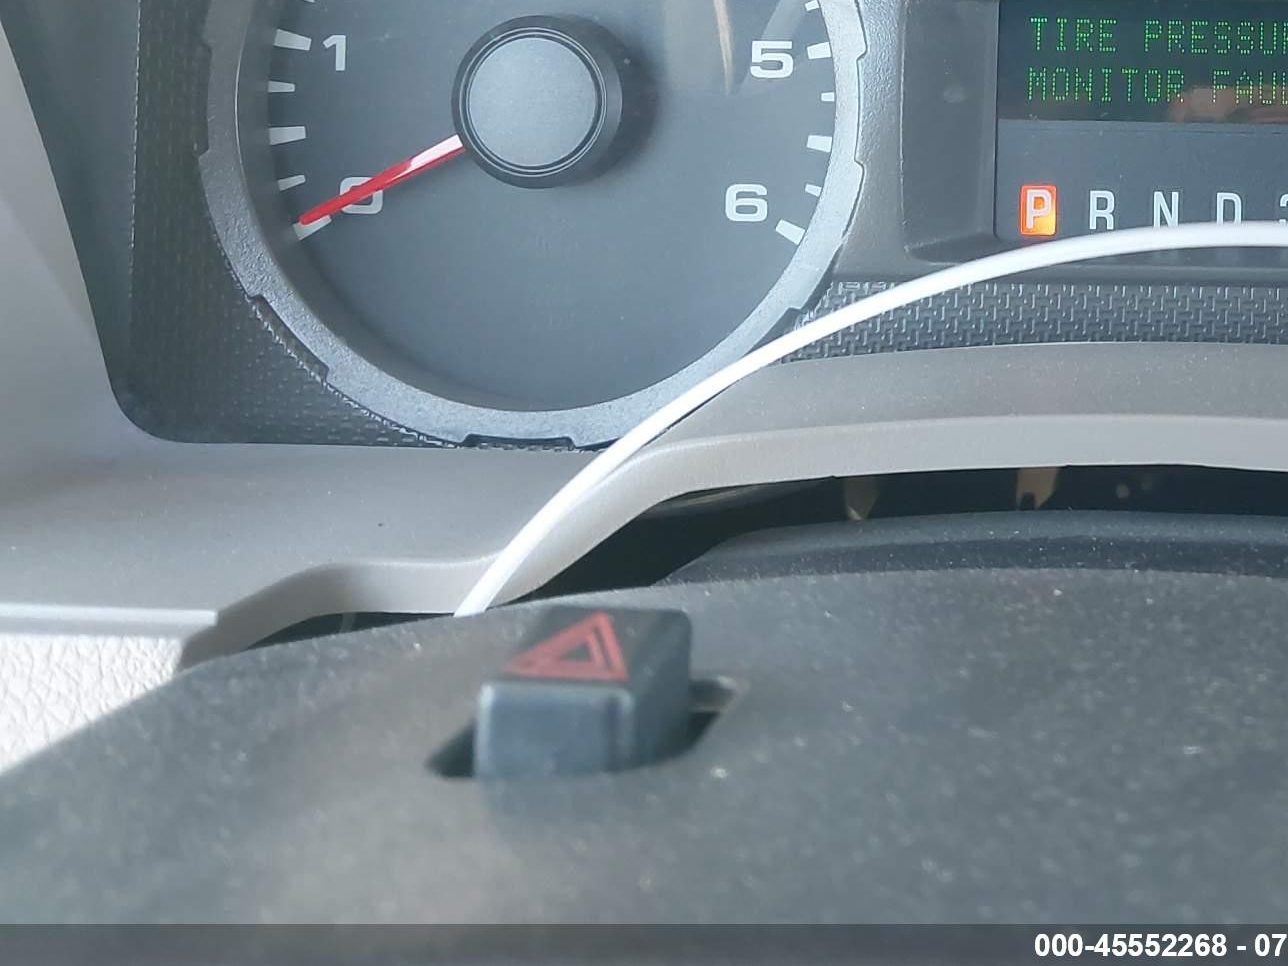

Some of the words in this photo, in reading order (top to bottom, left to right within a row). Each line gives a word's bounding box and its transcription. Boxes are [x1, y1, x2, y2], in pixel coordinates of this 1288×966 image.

[323, 35, 346, 71] 1
[1029, 17, 1117, 53] TIRE
[750, 40, 793, 79] 5
[1028, 68, 1185, 105] MONITOR
[340, 177, 384, 215] 0
[724, 184, 769, 223] 6
[1025, 189, 1053, 230] P
[1089, 190, 1115, 230] R
[1153, 191, 1180, 228] N
